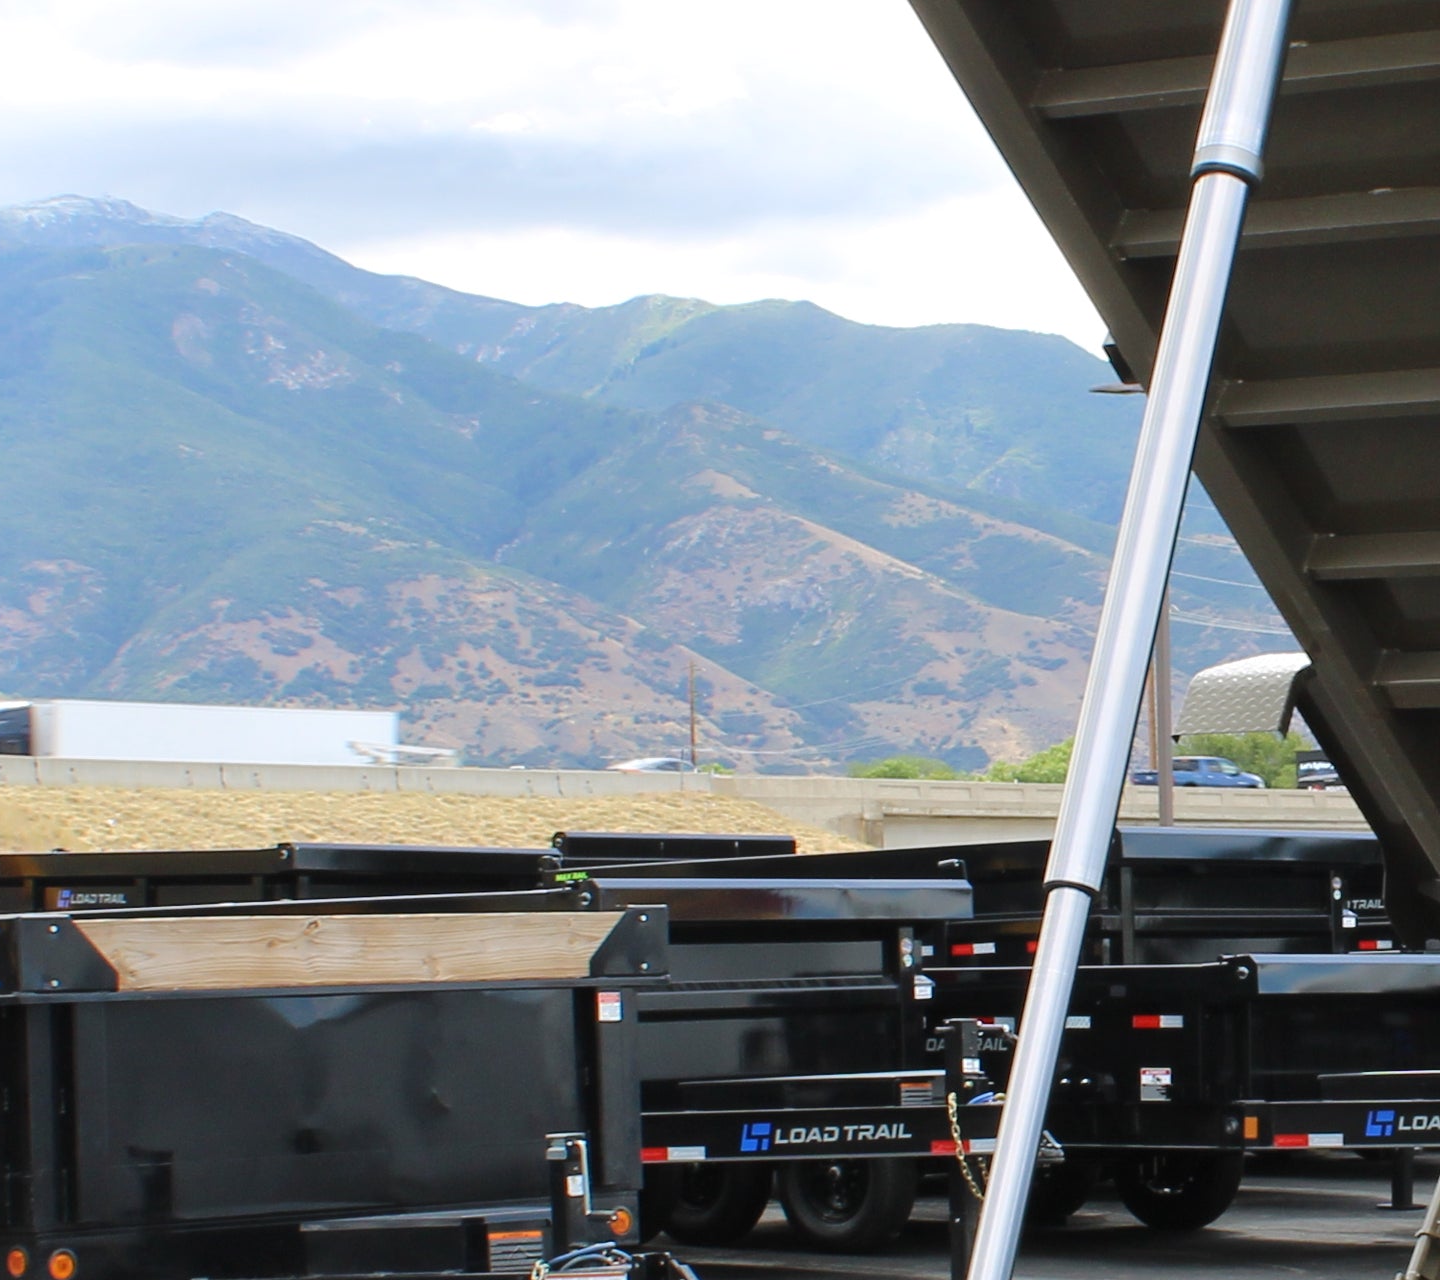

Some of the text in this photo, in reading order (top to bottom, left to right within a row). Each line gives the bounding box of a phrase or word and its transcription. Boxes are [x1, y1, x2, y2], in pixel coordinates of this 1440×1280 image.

[70, 892, 127, 905] LOAD TRAIL
[1352, 899, 1385, 910] TRAIL
[774, 1122, 913, 1145] LOAD TRAIL
